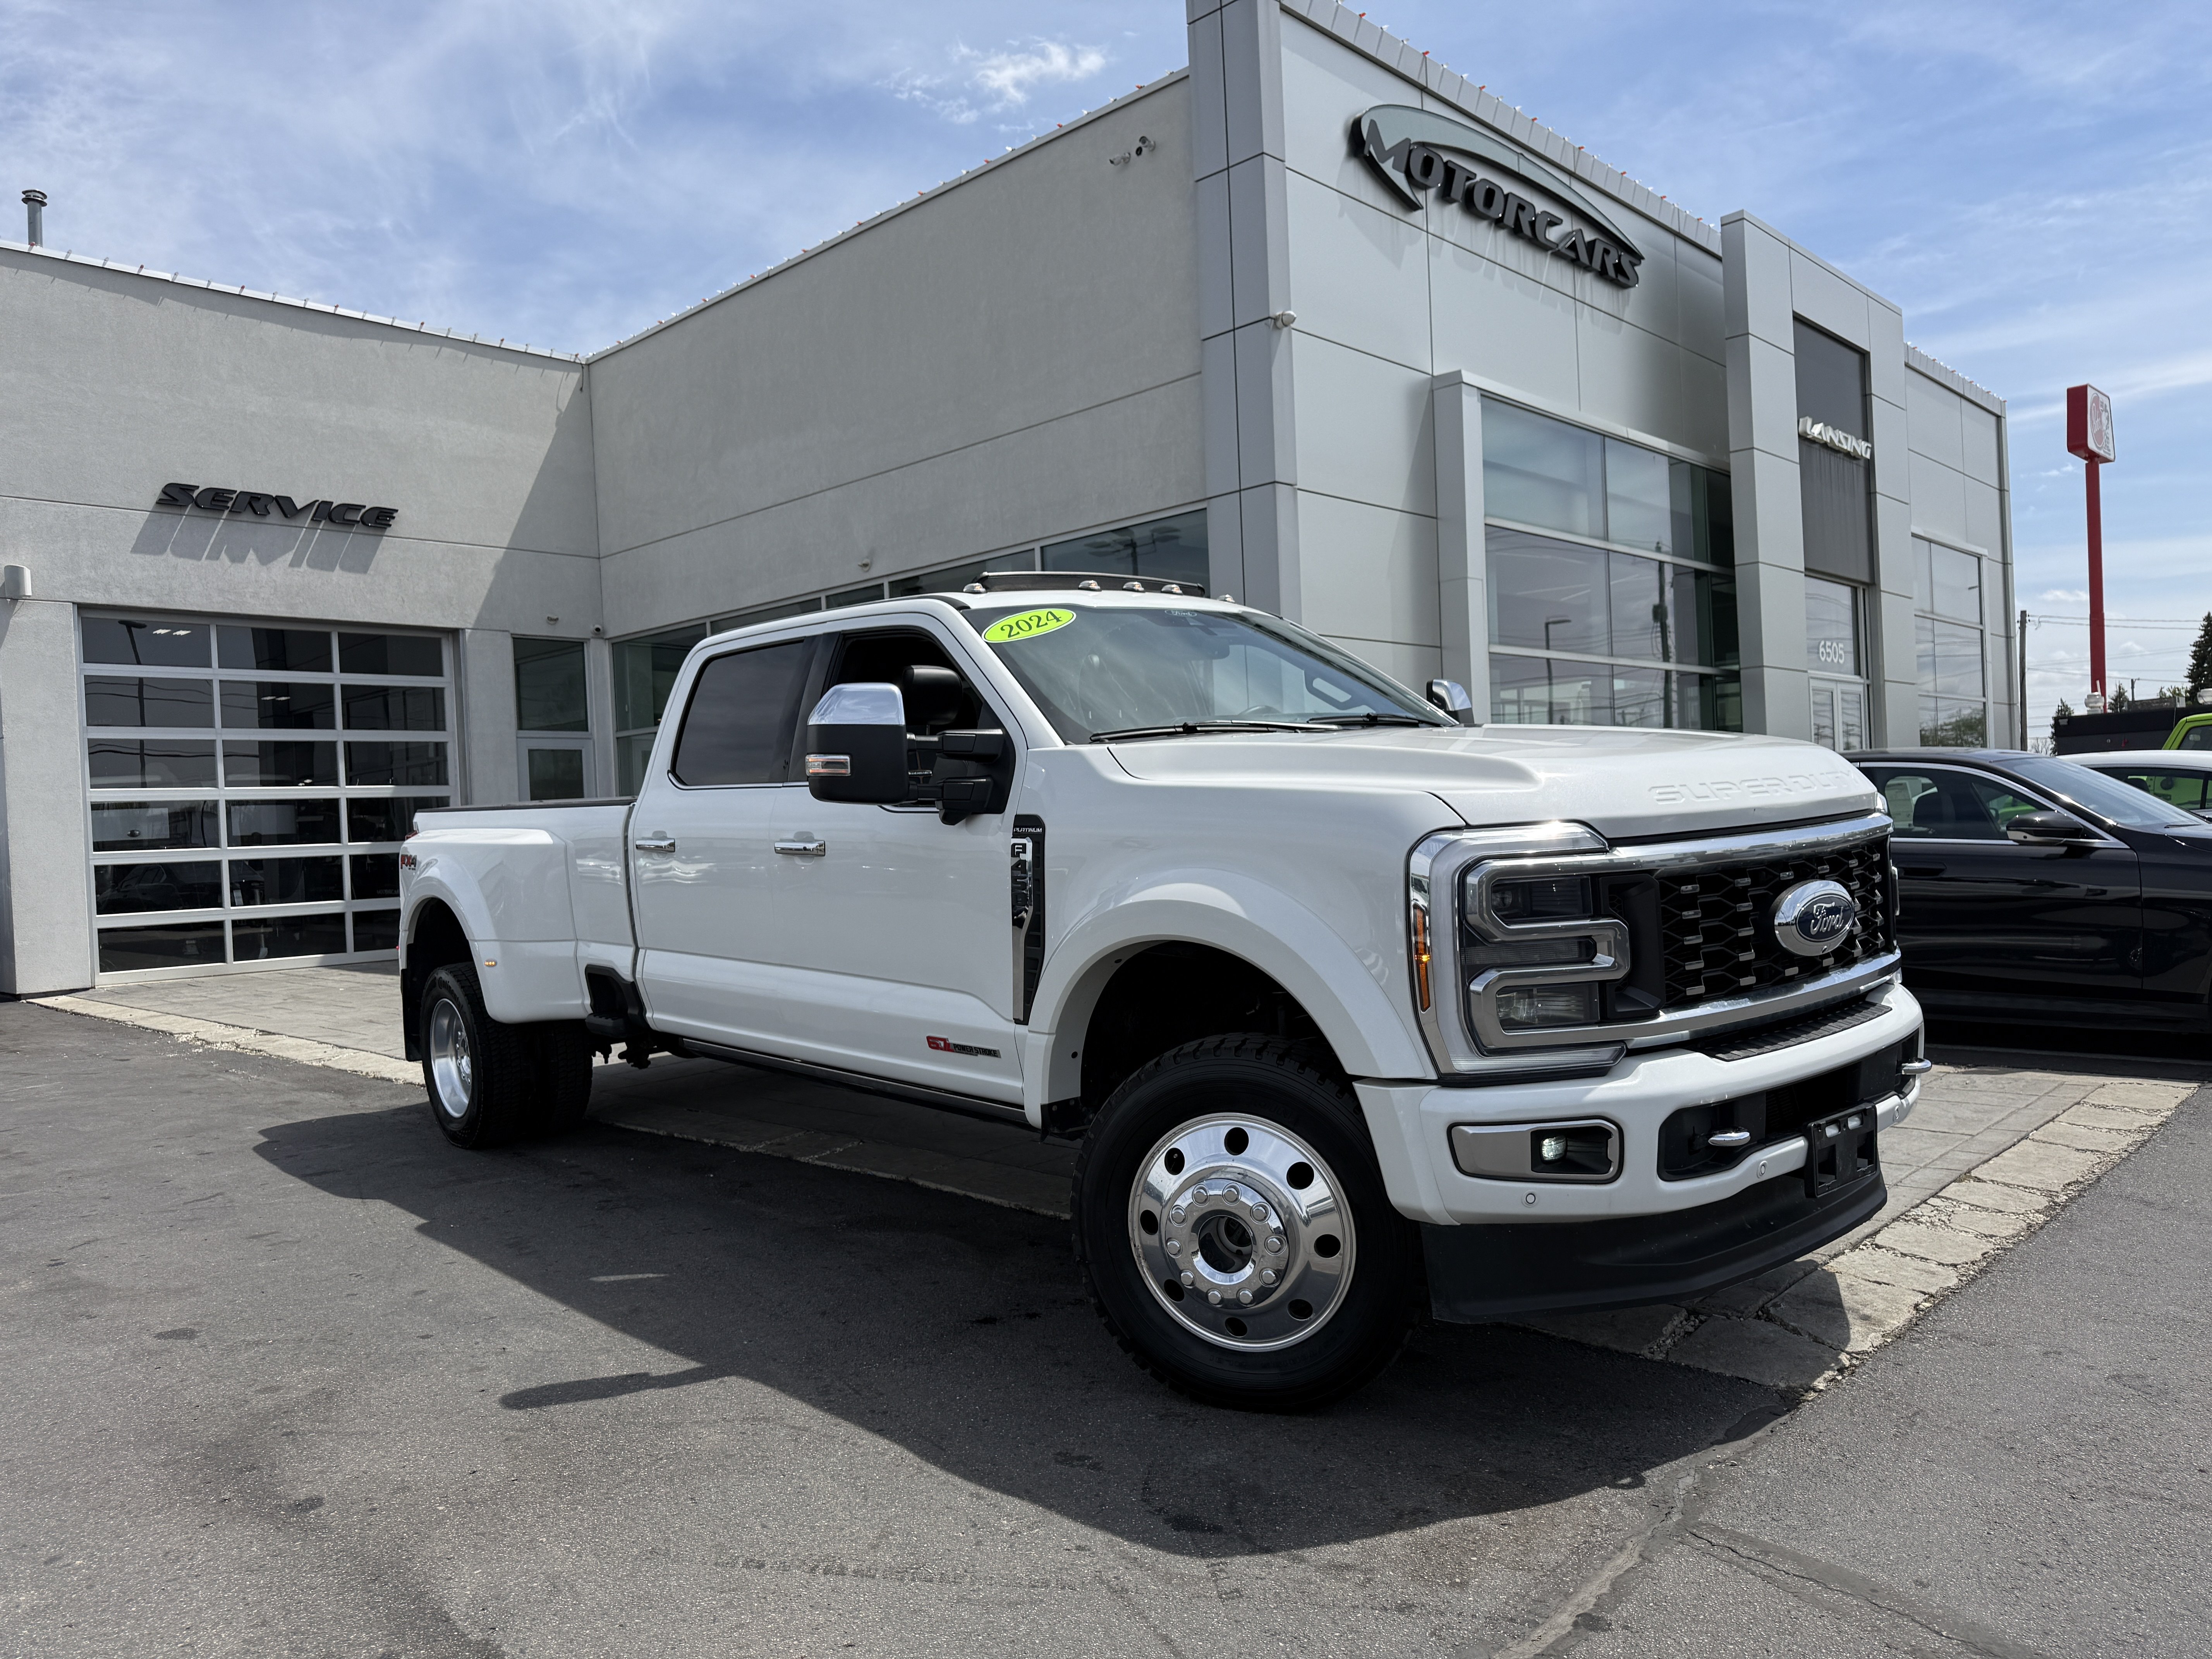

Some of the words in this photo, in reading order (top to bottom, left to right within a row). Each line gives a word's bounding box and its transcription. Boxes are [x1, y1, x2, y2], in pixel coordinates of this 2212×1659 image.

[1364, 118, 1642, 288] MOTORCARS
[1798, 416, 1872, 459] LANSING
[156, 483, 398, 528] SERVICE
[1000, 611, 1063, 638] 2024
[1819, 640, 1844, 664] 6505
[400, 854, 417, 869] FX4
[1810, 902, 1844, 935] Ford
[438, 977, 464, 1012] Continental
[953, 1043, 974, 1053] POWER
[974, 1047, 998, 1057] STROKE
